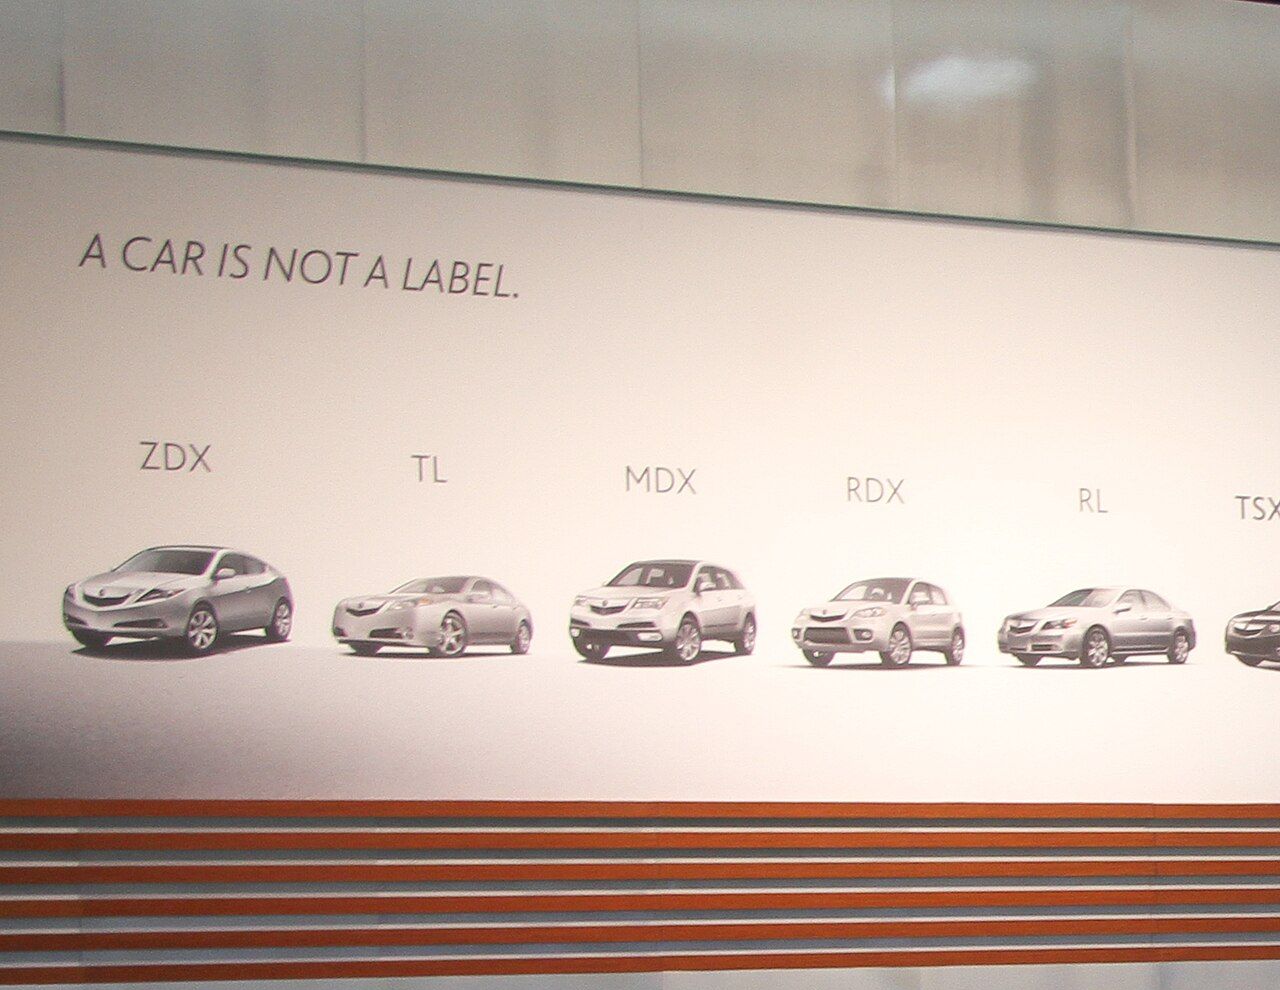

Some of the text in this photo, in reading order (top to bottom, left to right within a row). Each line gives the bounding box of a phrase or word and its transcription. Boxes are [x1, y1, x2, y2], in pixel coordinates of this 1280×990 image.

[78, 233, 520, 298] A CAR IS NOT A LABEL.
[139, 440, 212, 473] ZDX
[410, 454, 448, 484] TL
[625, 465, 697, 495] MDX
[846, 475, 905, 505] RDX
[1078, 486, 1109, 515] RL
